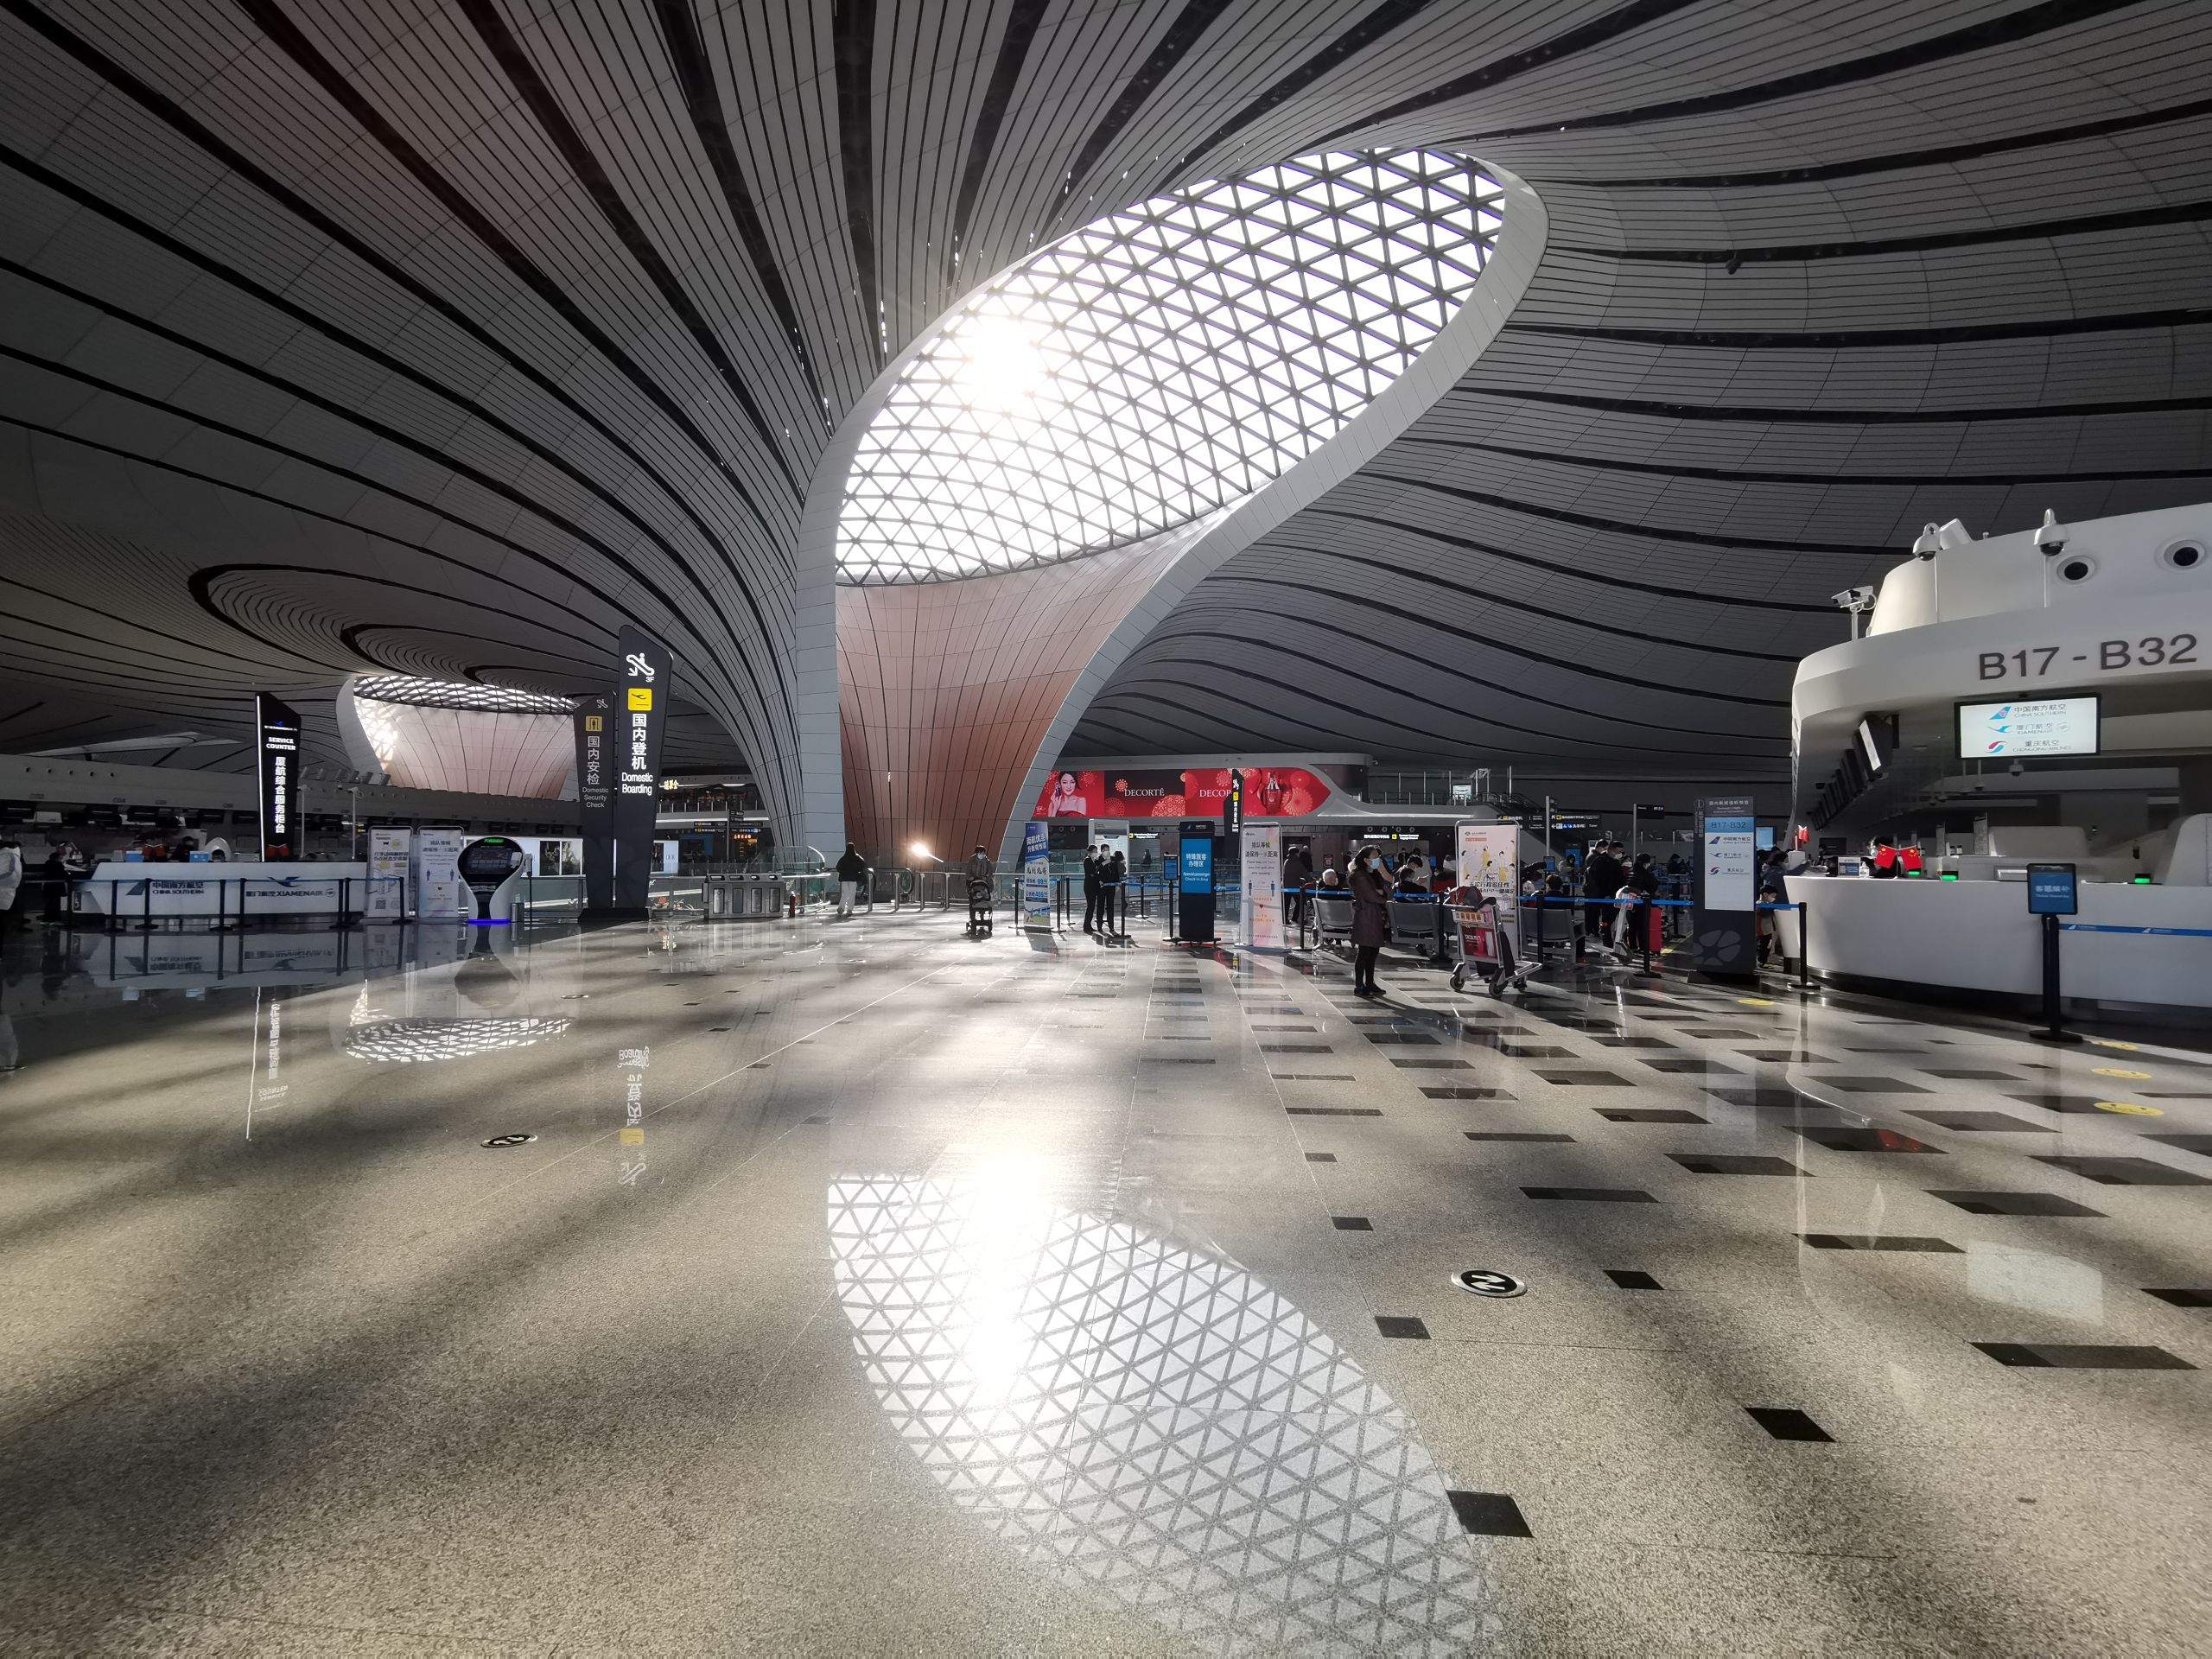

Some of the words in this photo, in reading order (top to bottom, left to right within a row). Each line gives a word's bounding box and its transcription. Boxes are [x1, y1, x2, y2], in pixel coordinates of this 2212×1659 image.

[1979, 646, 2060, 681] B17
[2101, 633, 2198, 671] B32
[2013, 703, 2067, 713] 中国南方航空
[631, 713, 647, 771] 国内登机
[587, 735, 601, 785] 国内安检
[621, 772, 653, 782] Domestic
[621, 784, 652, 797] Boarding
[275, 756, 286, 834] 厦航综合服务柜台
[152, 880, 204, 889] 中国南方航空
